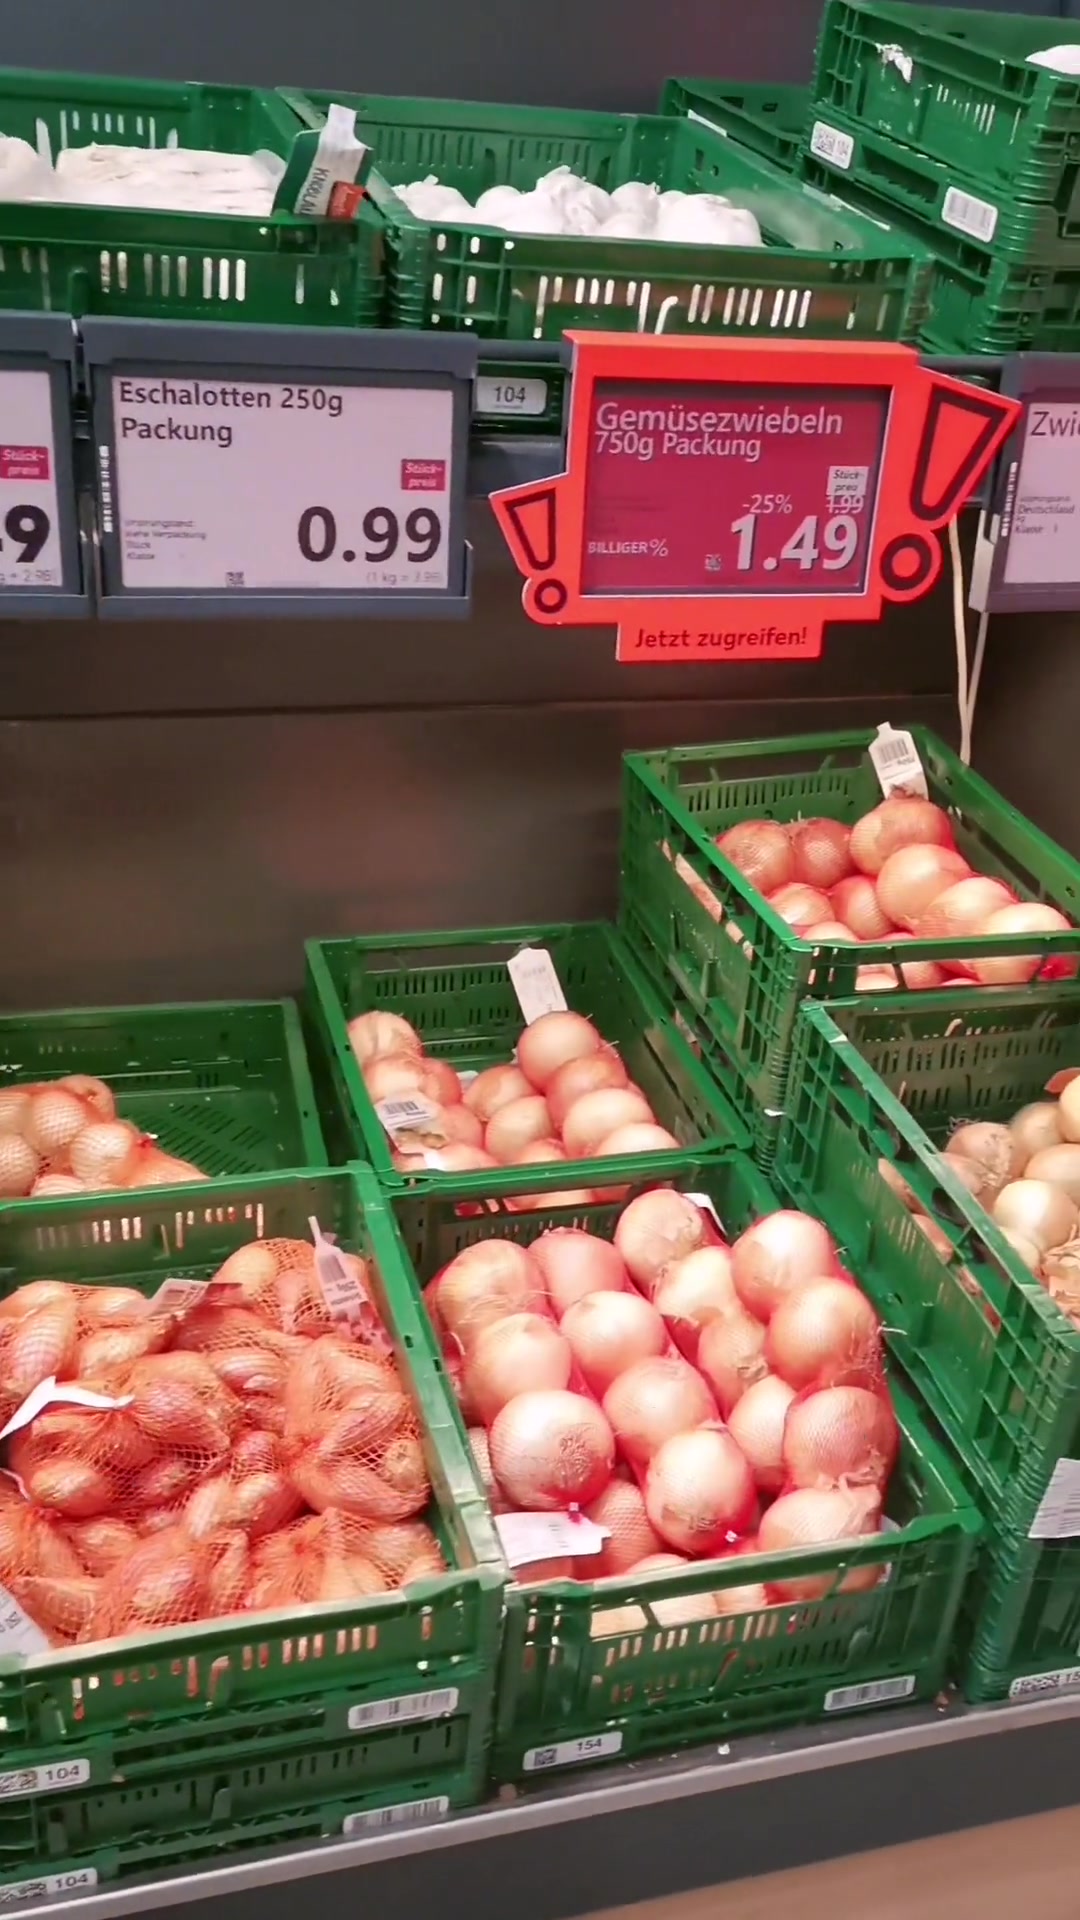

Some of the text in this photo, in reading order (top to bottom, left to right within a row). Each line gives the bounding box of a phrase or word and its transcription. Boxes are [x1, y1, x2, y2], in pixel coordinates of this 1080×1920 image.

[119, 380, 344, 417] Eschalotten 250g
[494, 386, 526, 404] 104
[121, 416, 233, 448] Packung
[595, 402, 843, 435] Gemüsezwiebeln
[1030, 410, 1080, 437] Zwi
[594, 431, 762, 463] 750g Packung
[742, 494, 793, 515] -25%
[825, 494, 865, 515] 1.99
[0, 504, 51, 563] 9
[297, 505, 442, 563] 0.99
[731, 512, 859, 571] 1.49
[634, 626, 807, 651] Jetzt zugreifen!
[576, 1737, 603, 1752] 154
[45, 1764, 81, 1782] 104
[55, 1873, 89, 1889] 104
